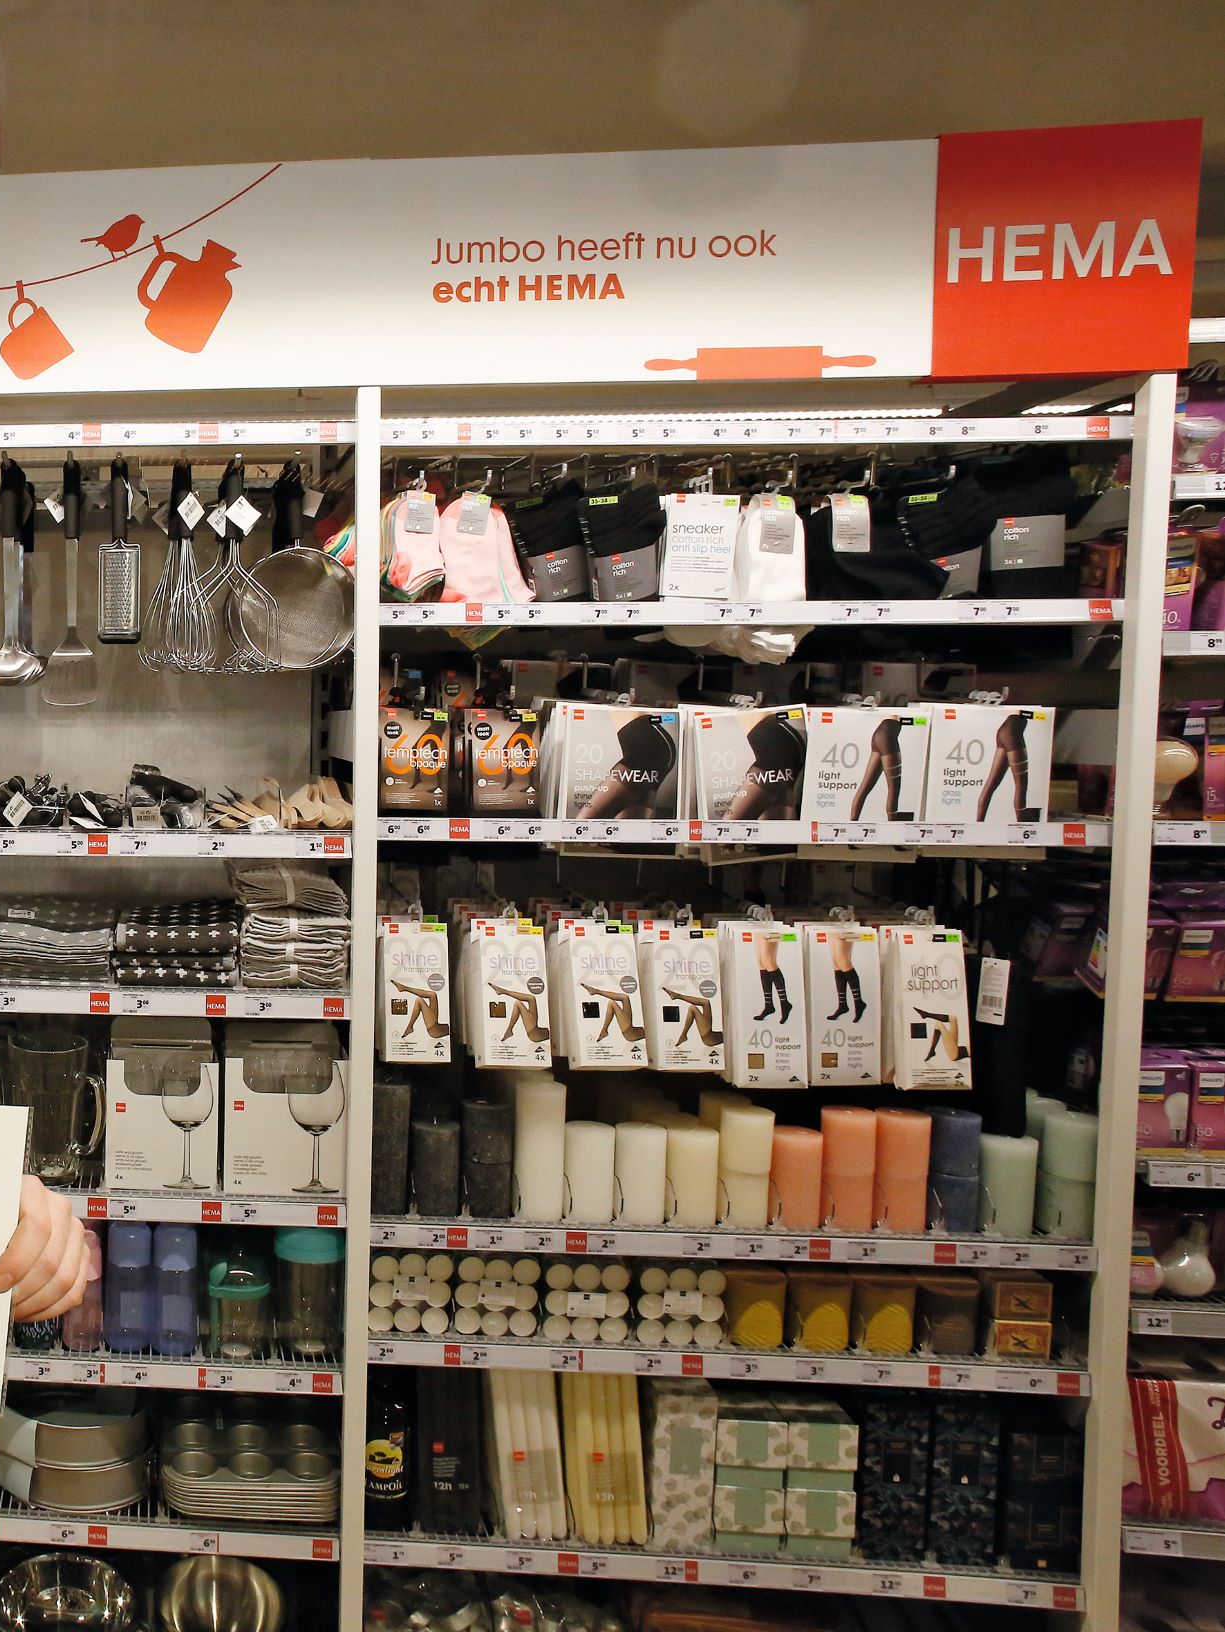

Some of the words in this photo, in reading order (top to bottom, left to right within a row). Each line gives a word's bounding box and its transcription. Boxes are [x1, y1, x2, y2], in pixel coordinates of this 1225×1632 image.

[431, 234, 546, 265] Jumbo
[556, 231, 644, 262] heeft
[655, 237, 696, 259] nu
[707, 230, 776, 258] ook
[947, 218, 1172, 285] HEMA
[432, 275, 509, 305] echt
[518, 272, 625, 302] HEMA
[672, 523, 724, 535] sneaker
[1004, 527, 1029, 535] cotton
[672, 535, 702, 544] cotton
[706, 536, 724, 544] rich
[1004, 533, 1019, 541] rich
[672, 544, 690, 553] anti
[692, 544, 708, 555] slip
[710, 545, 731, 554] heel
[547, 558, 568, 568] cotton
[612, 561, 635, 571] cotton
[548, 565, 561, 575] rich
[613, 568, 626, 577] rich
[384, 746, 447, 762] temptech
[386, 733, 444, 775] 60
[475, 746, 538, 762] temptech
[477, 732, 534, 775] 60
[576, 744, 604, 764] 20
[820, 742, 860, 769] 40
[945, 738, 985, 766] 40
[410, 760, 446, 770] opaque
[501, 760, 537, 769] opaque
[575, 769, 659, 783] SHAPEWEAR
[711, 769, 794, 789] SHAPEWEAR
[818, 771, 840, 783] light
[943, 768, 967, 779] light
[818, 781, 857, 791] support
[943, 777, 984, 787] support
[574, 784, 609, 794] push-up
[574, 792, 592, 801] shine
[712, 790, 747, 801] push-up
[714, 800, 732, 808] shine
[392, 952, 438, 967] shine
[489, 954, 536, 970] shine
[581, 954, 627, 969] shine
[403, 966, 442, 974] transparent
[664, 958, 710, 974] shine
[911, 964, 938, 980] light
[501, 969, 539, 977] transparent
[593, 969, 632, 977] transparent
[907, 978, 958, 993] support
[748, 1029, 773, 1049] 40
[821, 1028, 846, 1047] 40
[1152, 1412, 1171, 1487] VOORDEEL
[433, 1482, 452, 1491] 12h
